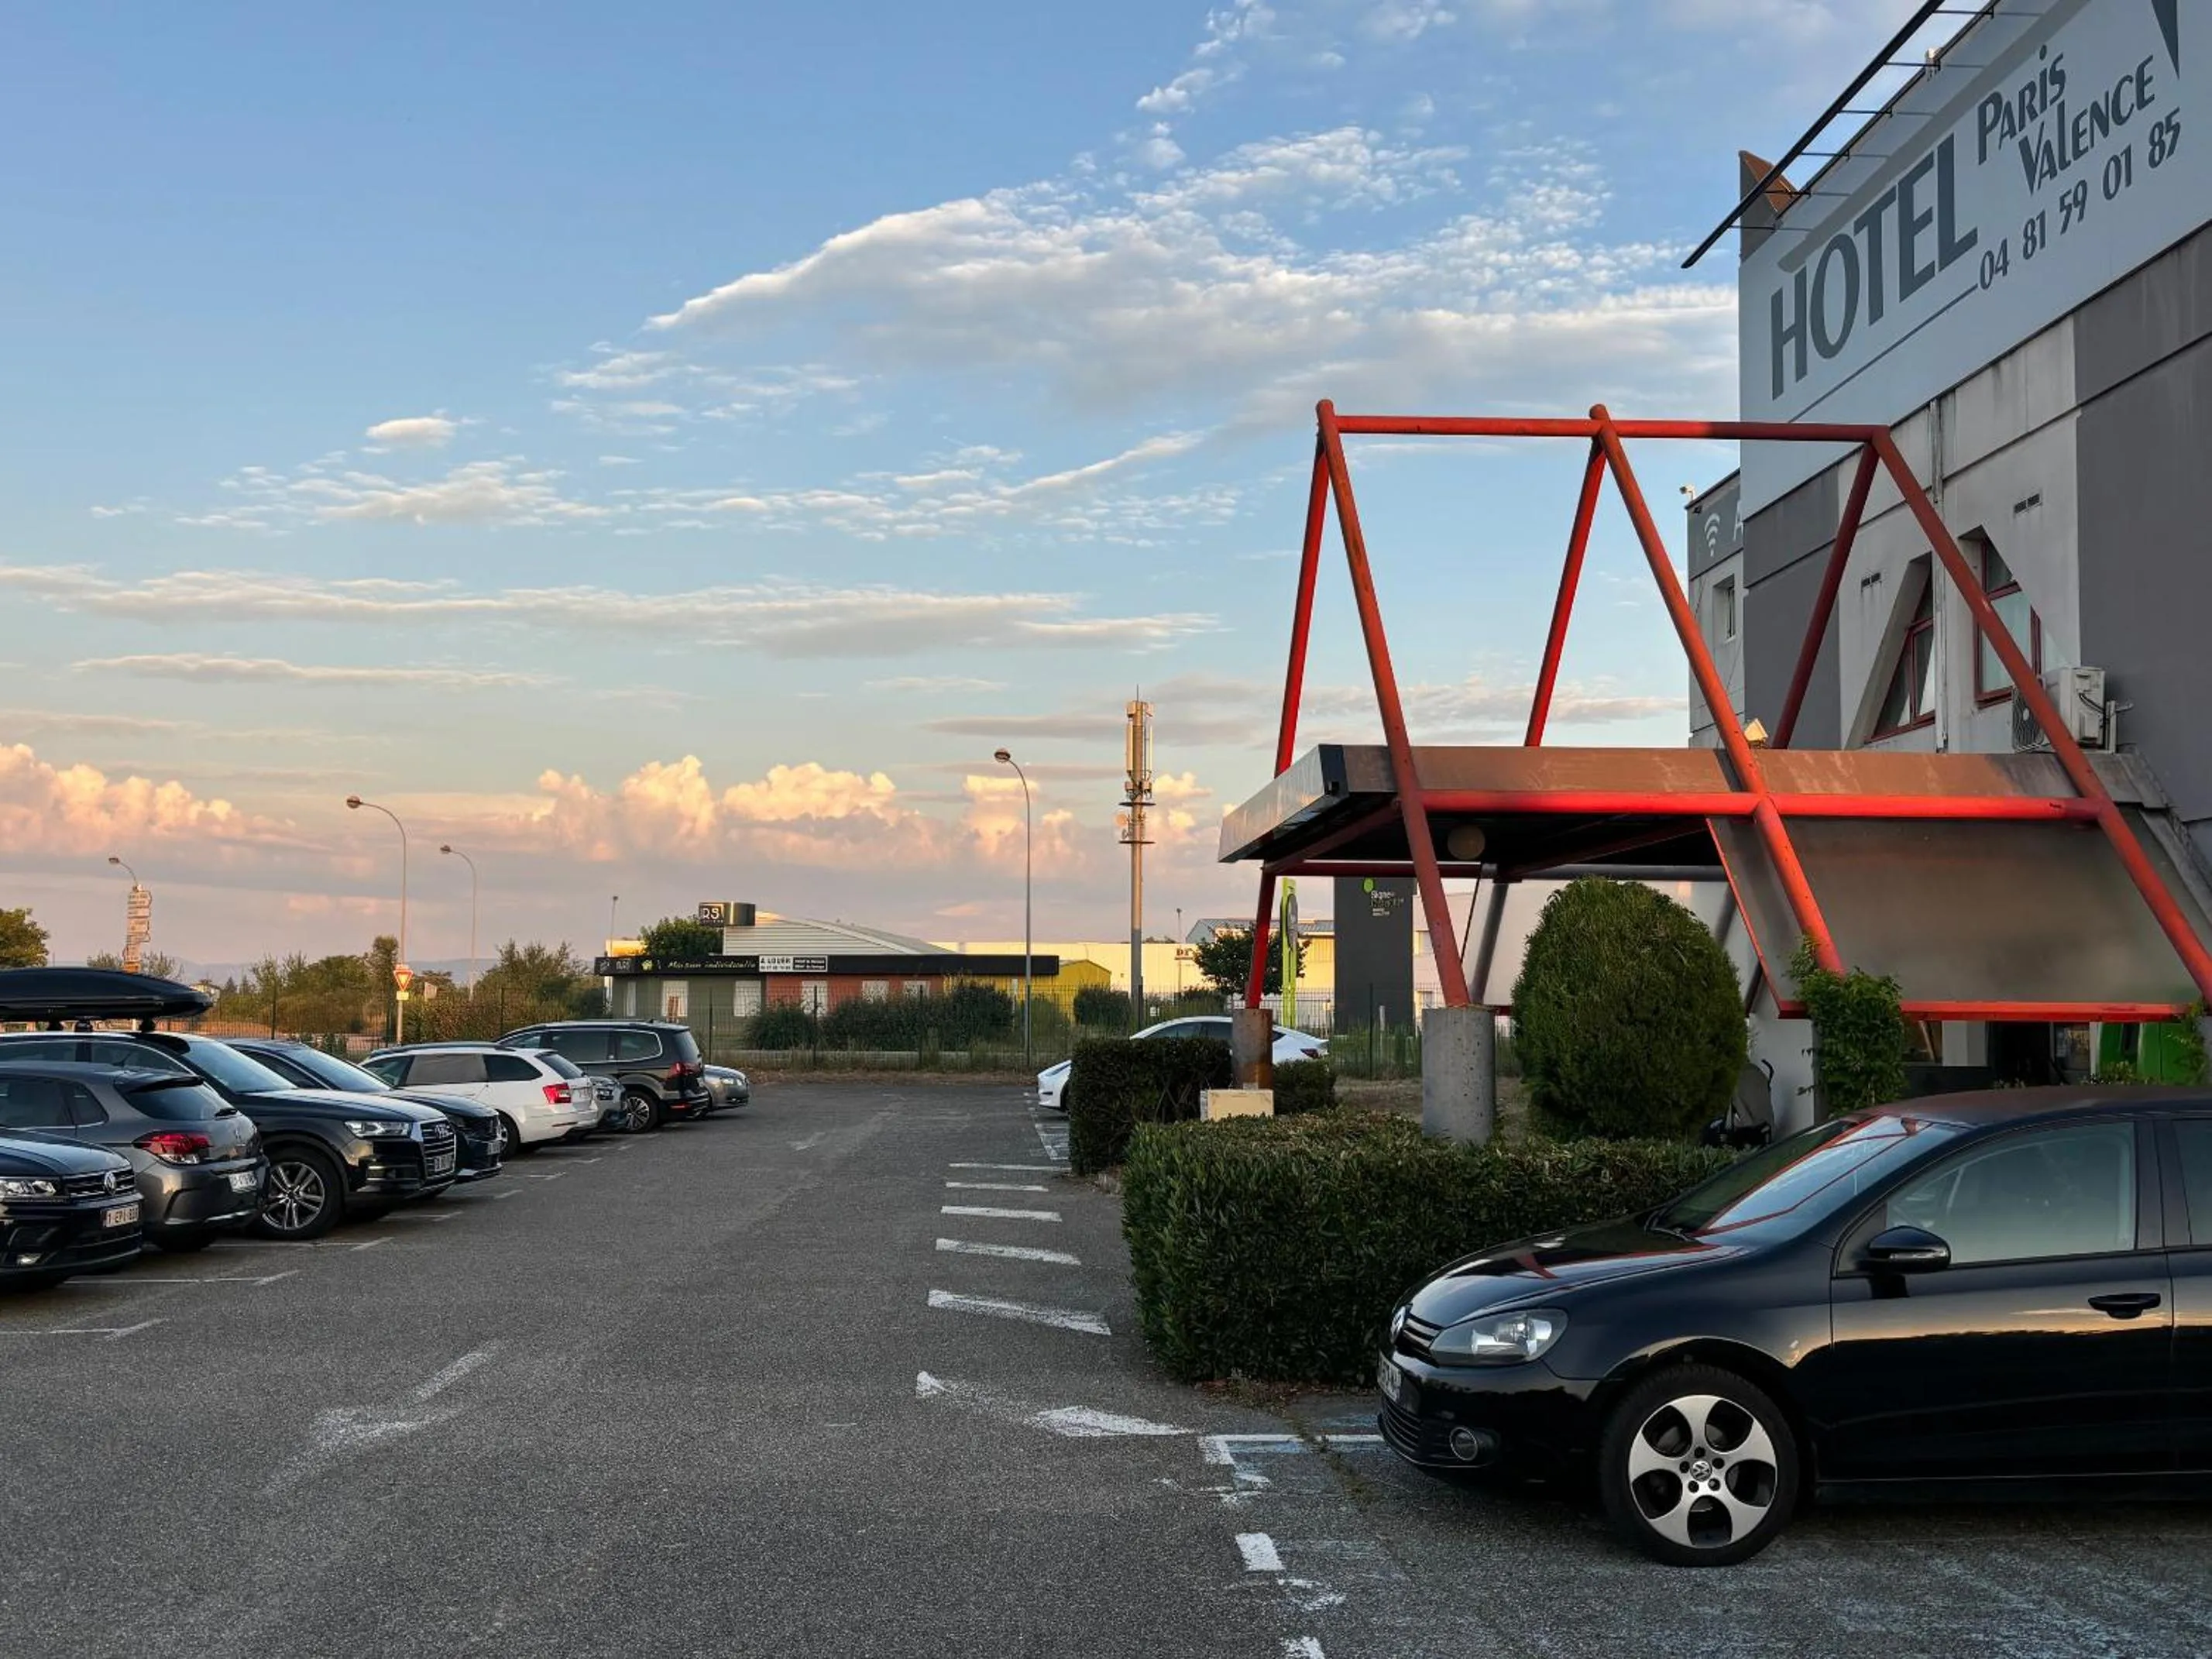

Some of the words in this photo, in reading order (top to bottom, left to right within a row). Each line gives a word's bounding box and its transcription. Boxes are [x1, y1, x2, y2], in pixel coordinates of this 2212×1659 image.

[1771, 132, 1978, 401] HOTEL
[1980, 237, 2010, 290] 04
[2022, 209, 2046, 260] 81
[2059, 179, 2088, 235] 59
[2102, 143, 2132, 201] 01
[2148, 106, 2181, 169] 85
